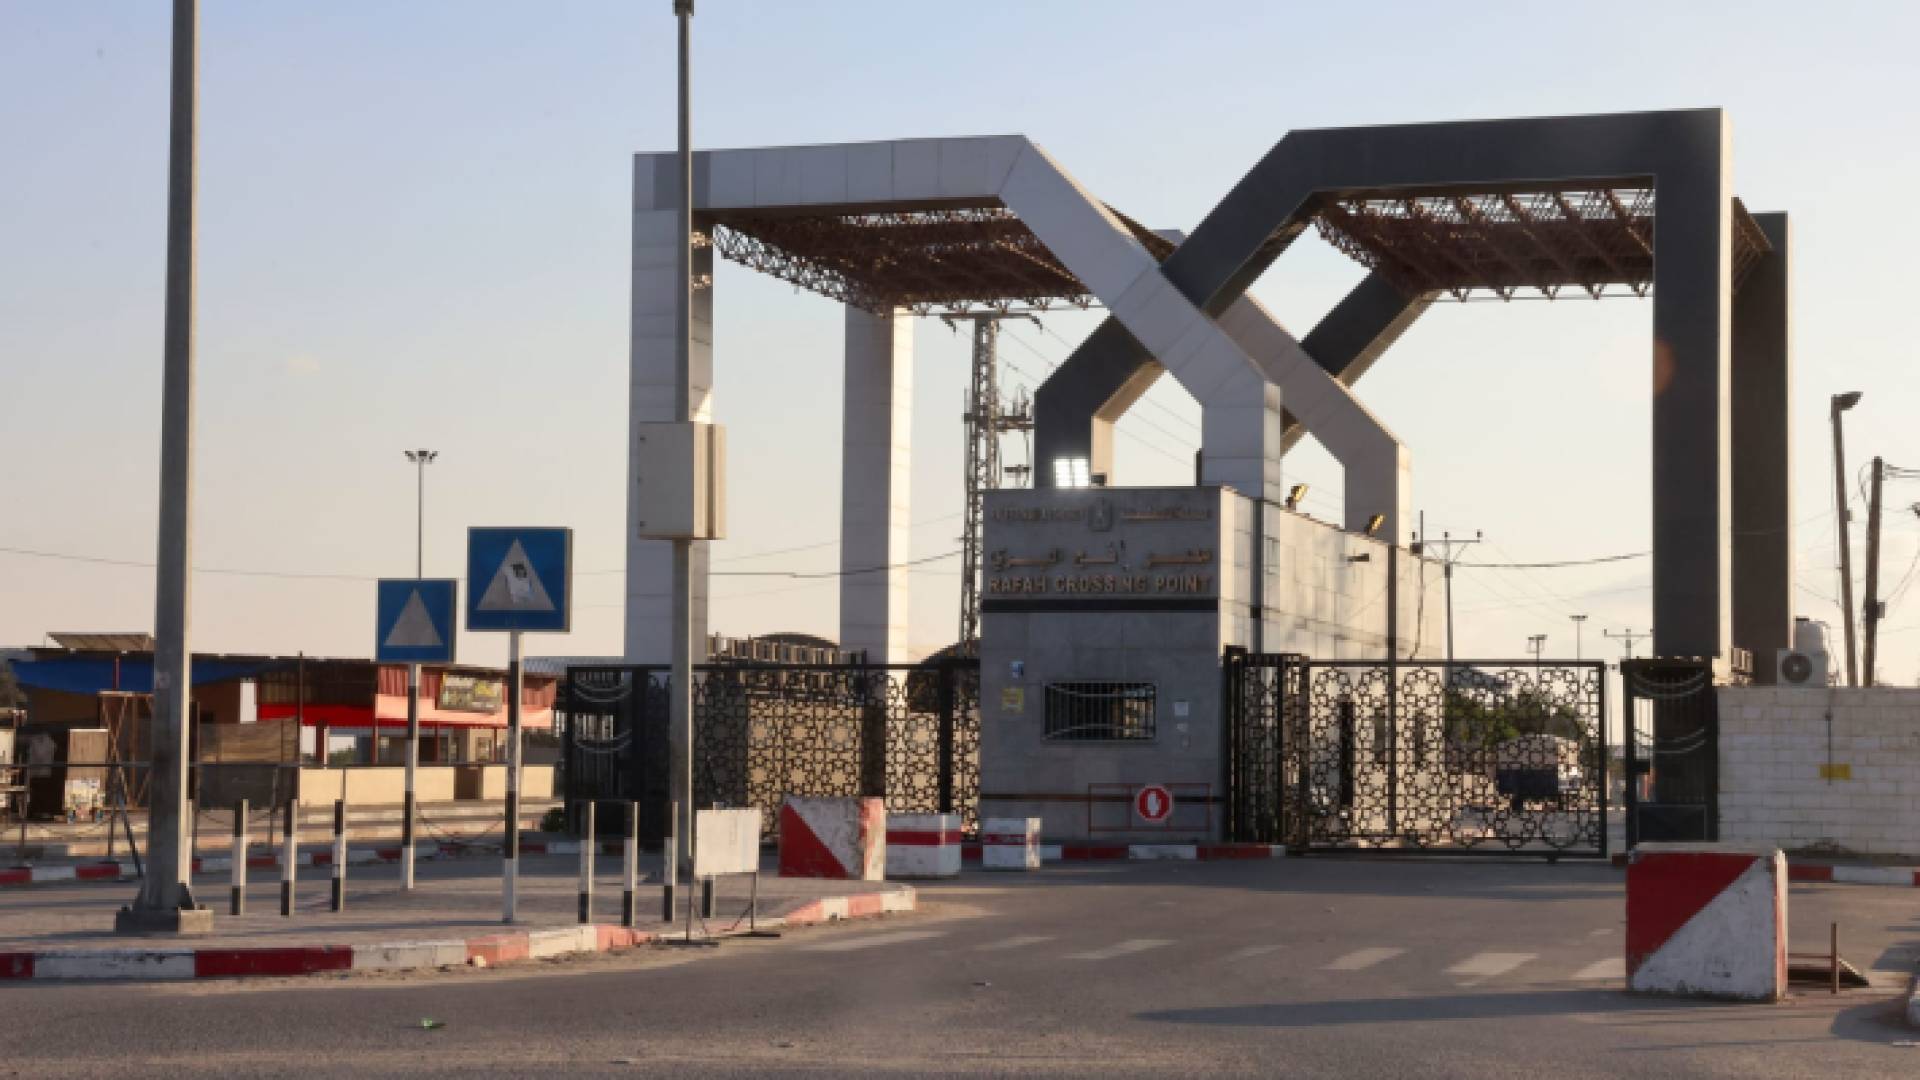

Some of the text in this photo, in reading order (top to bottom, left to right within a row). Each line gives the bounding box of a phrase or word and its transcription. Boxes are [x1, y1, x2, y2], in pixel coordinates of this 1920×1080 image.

[989, 574, 1211, 592] RAFAH CROSSNG POINT
